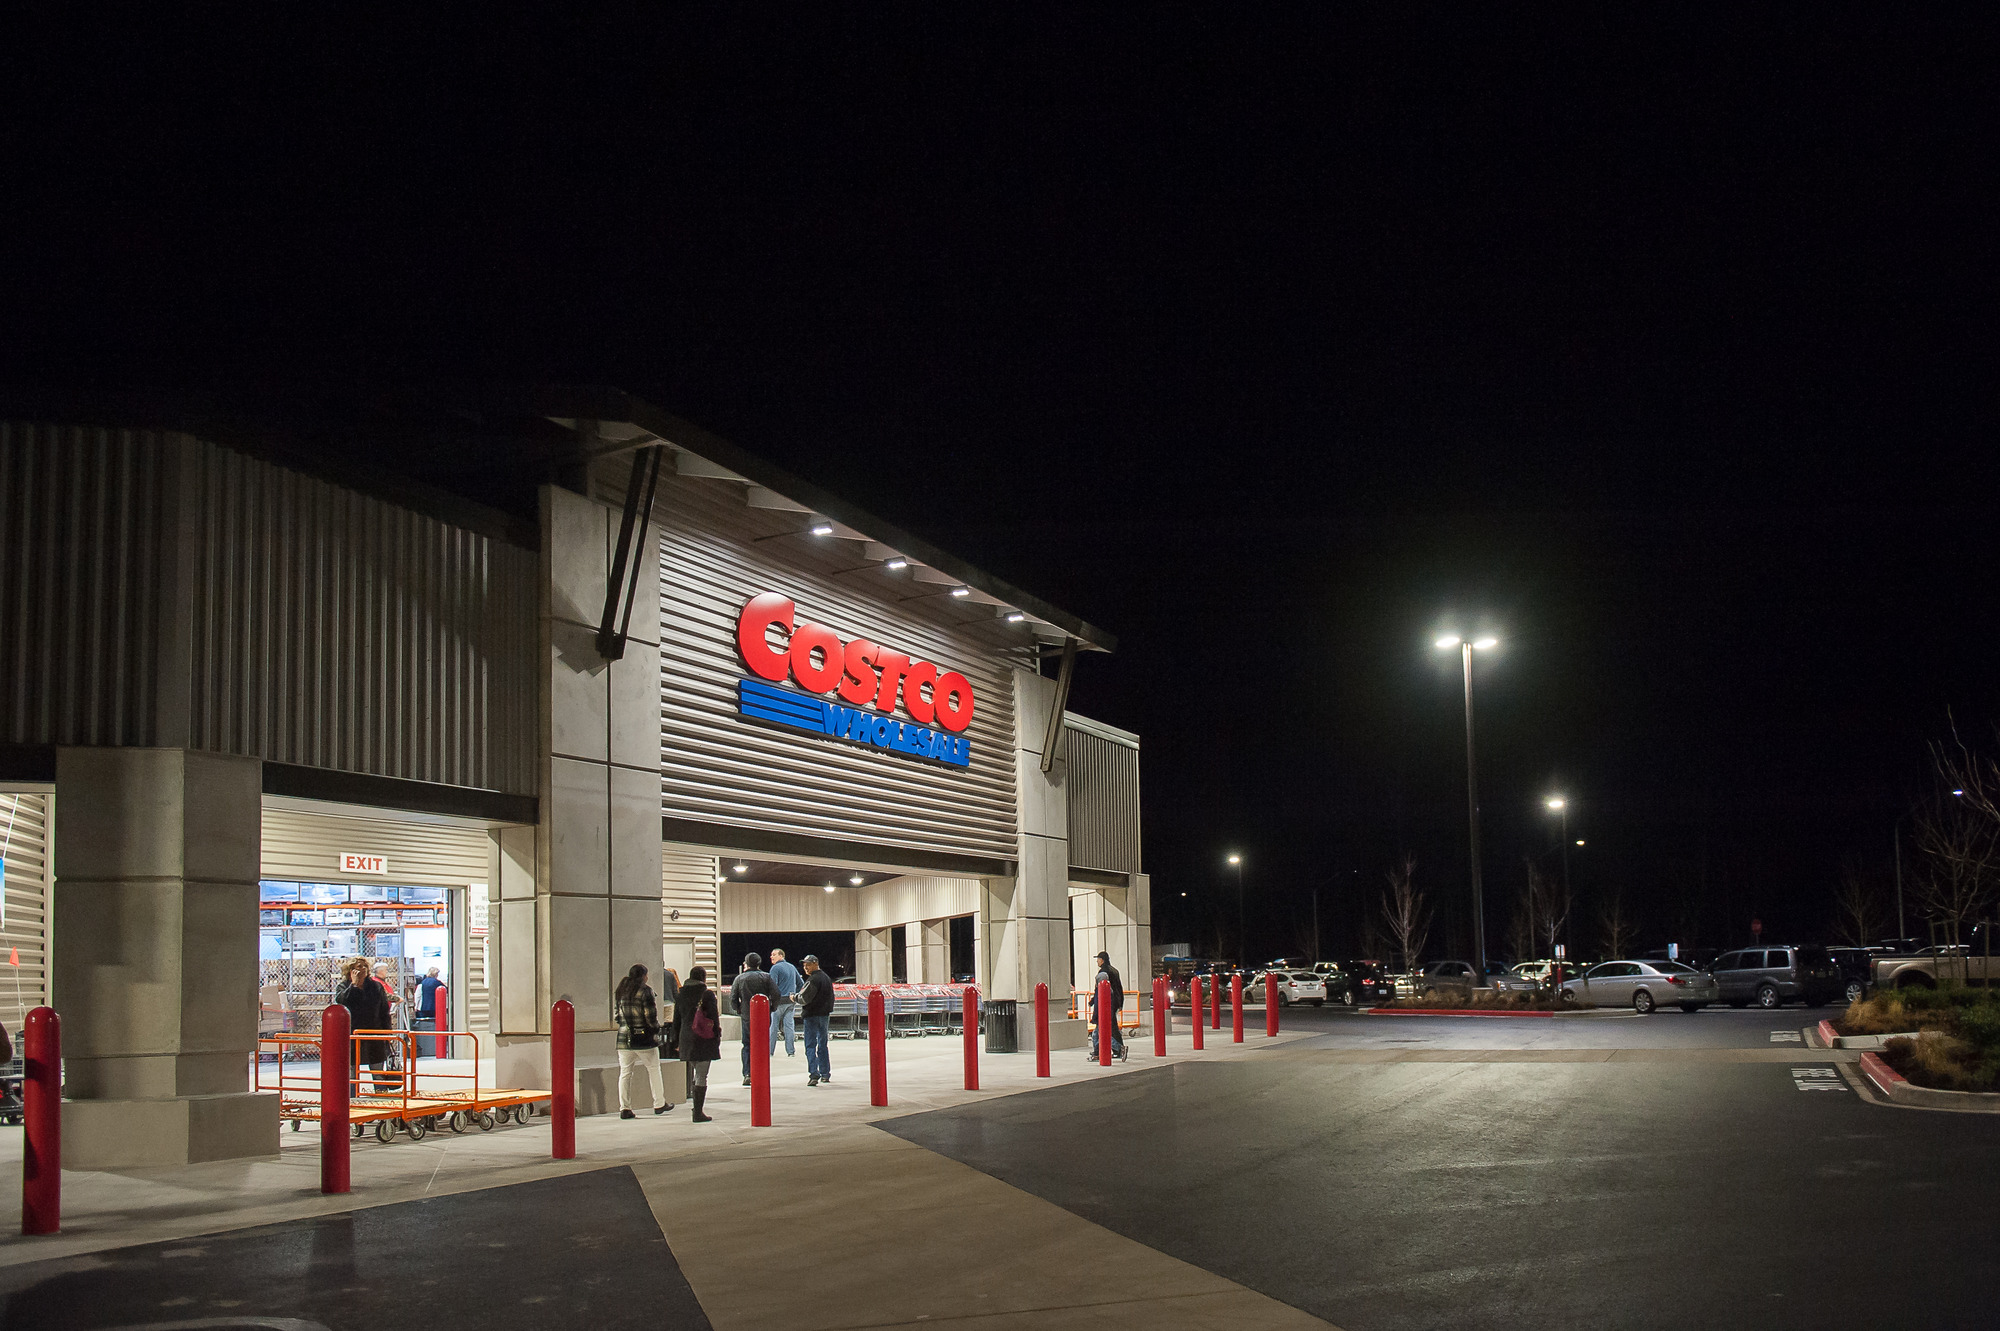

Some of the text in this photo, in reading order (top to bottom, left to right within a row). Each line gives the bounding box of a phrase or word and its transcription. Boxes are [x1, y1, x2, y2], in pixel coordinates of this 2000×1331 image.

[737, 592, 974, 732] COSTCO
[821, 702, 971, 767] WHOLESALE
[346, 855, 383, 871] EXIT
